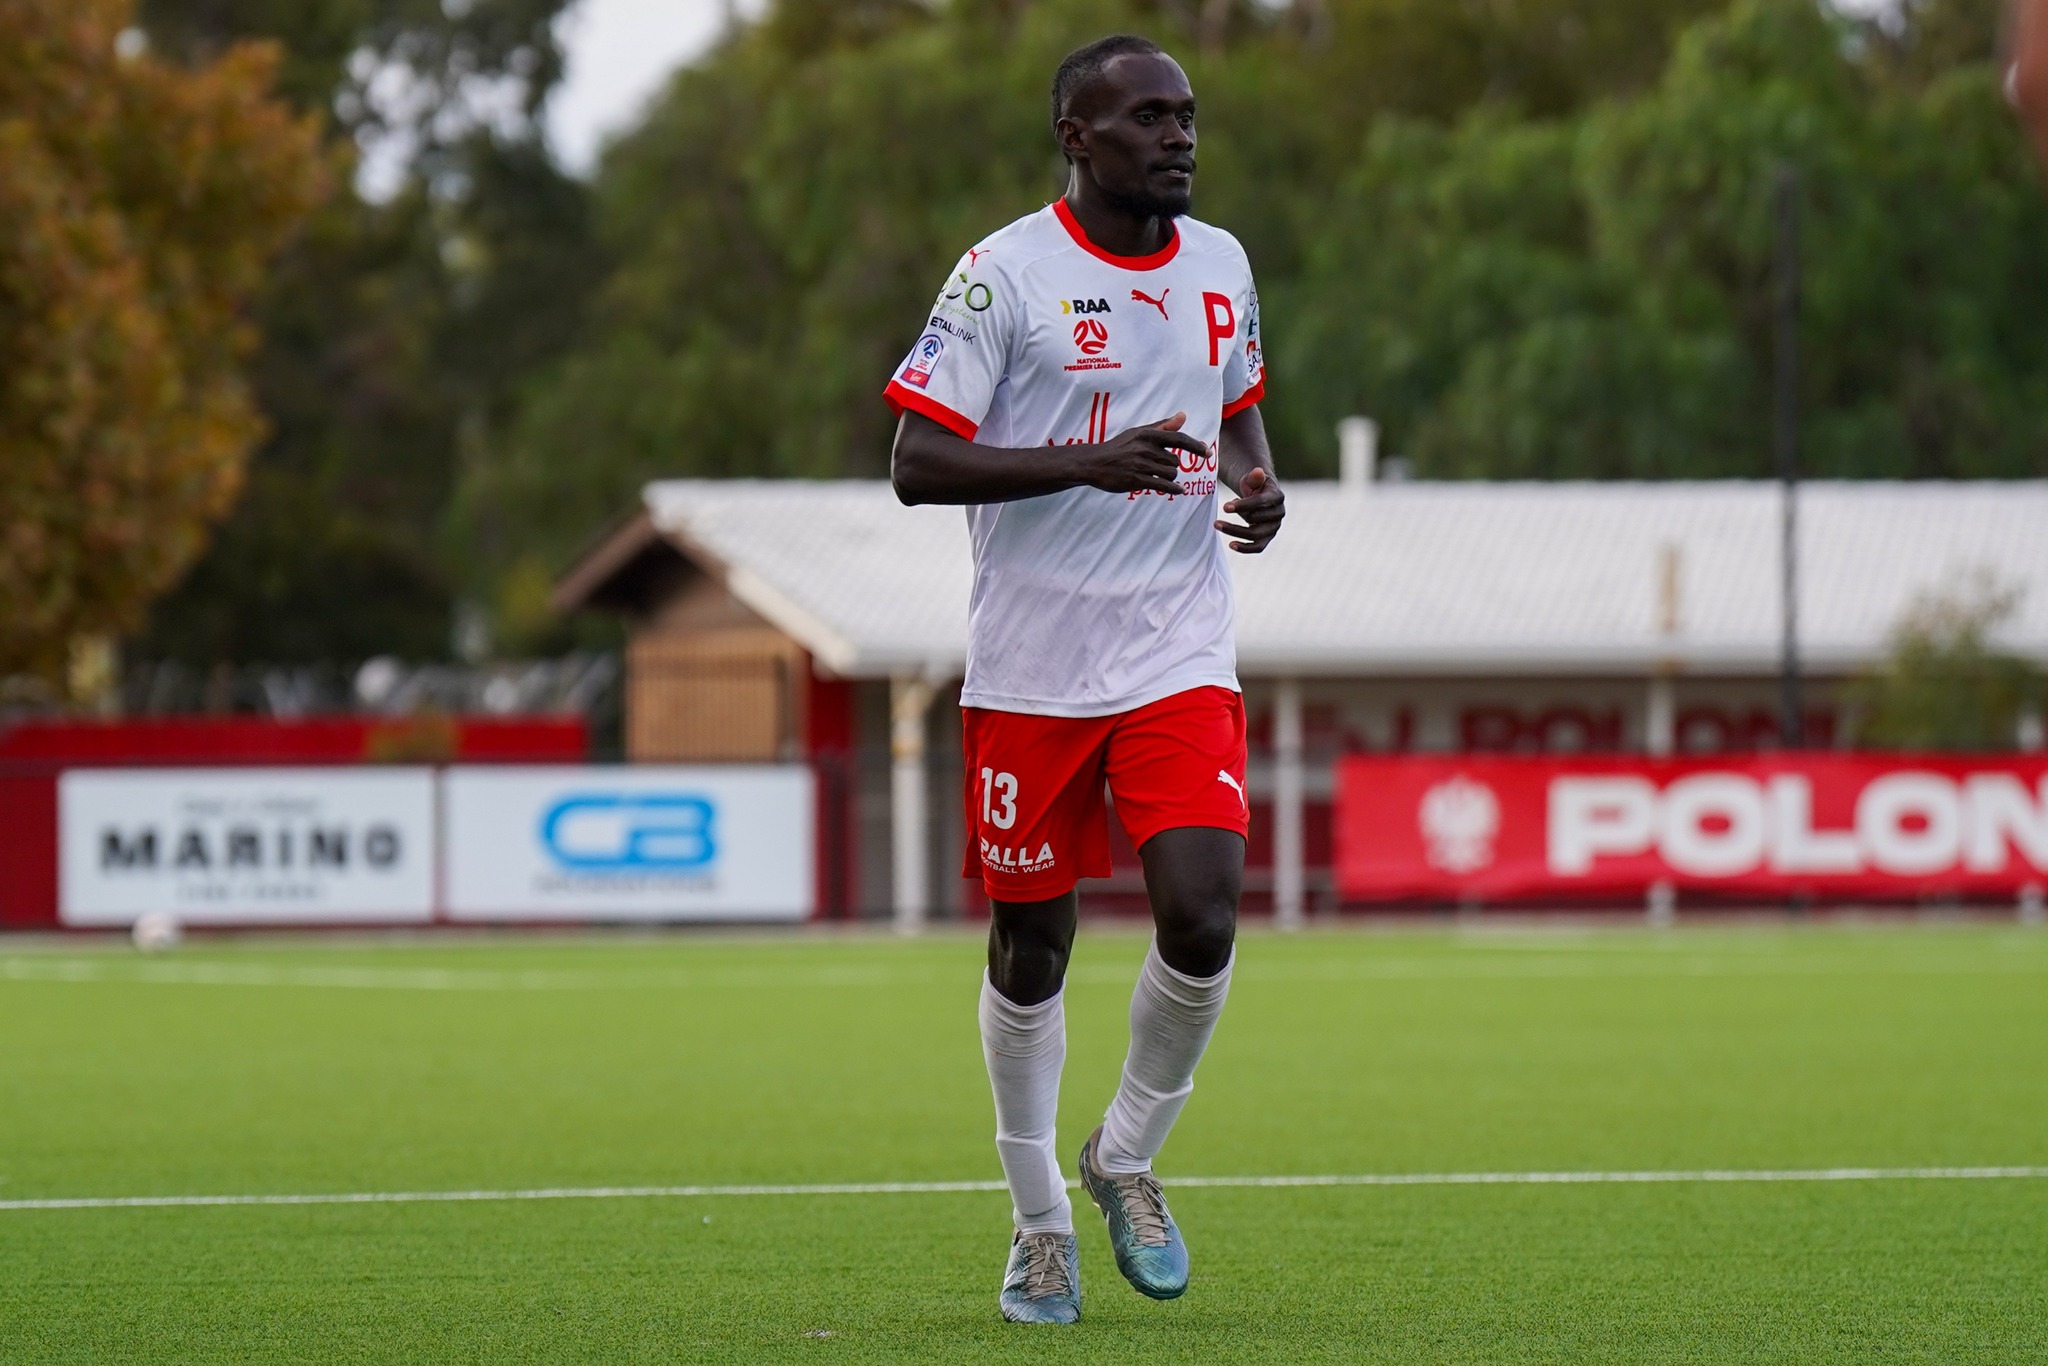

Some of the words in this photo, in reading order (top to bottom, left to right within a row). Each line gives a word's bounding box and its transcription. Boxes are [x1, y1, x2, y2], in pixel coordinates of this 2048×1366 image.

[1072, 298, 1112, 314] RAA
[1202, 291, 1236, 366] P
[1094, 362, 1122, 370] LEAGUES
[981, 766, 1018, 830] 13
[1545, 772, 2048, 876] POLON
[100, 823, 402, 873] MARINO
[980, 836, 1054, 866] PALLA
[1022, 860, 1055, 873] WEAR
